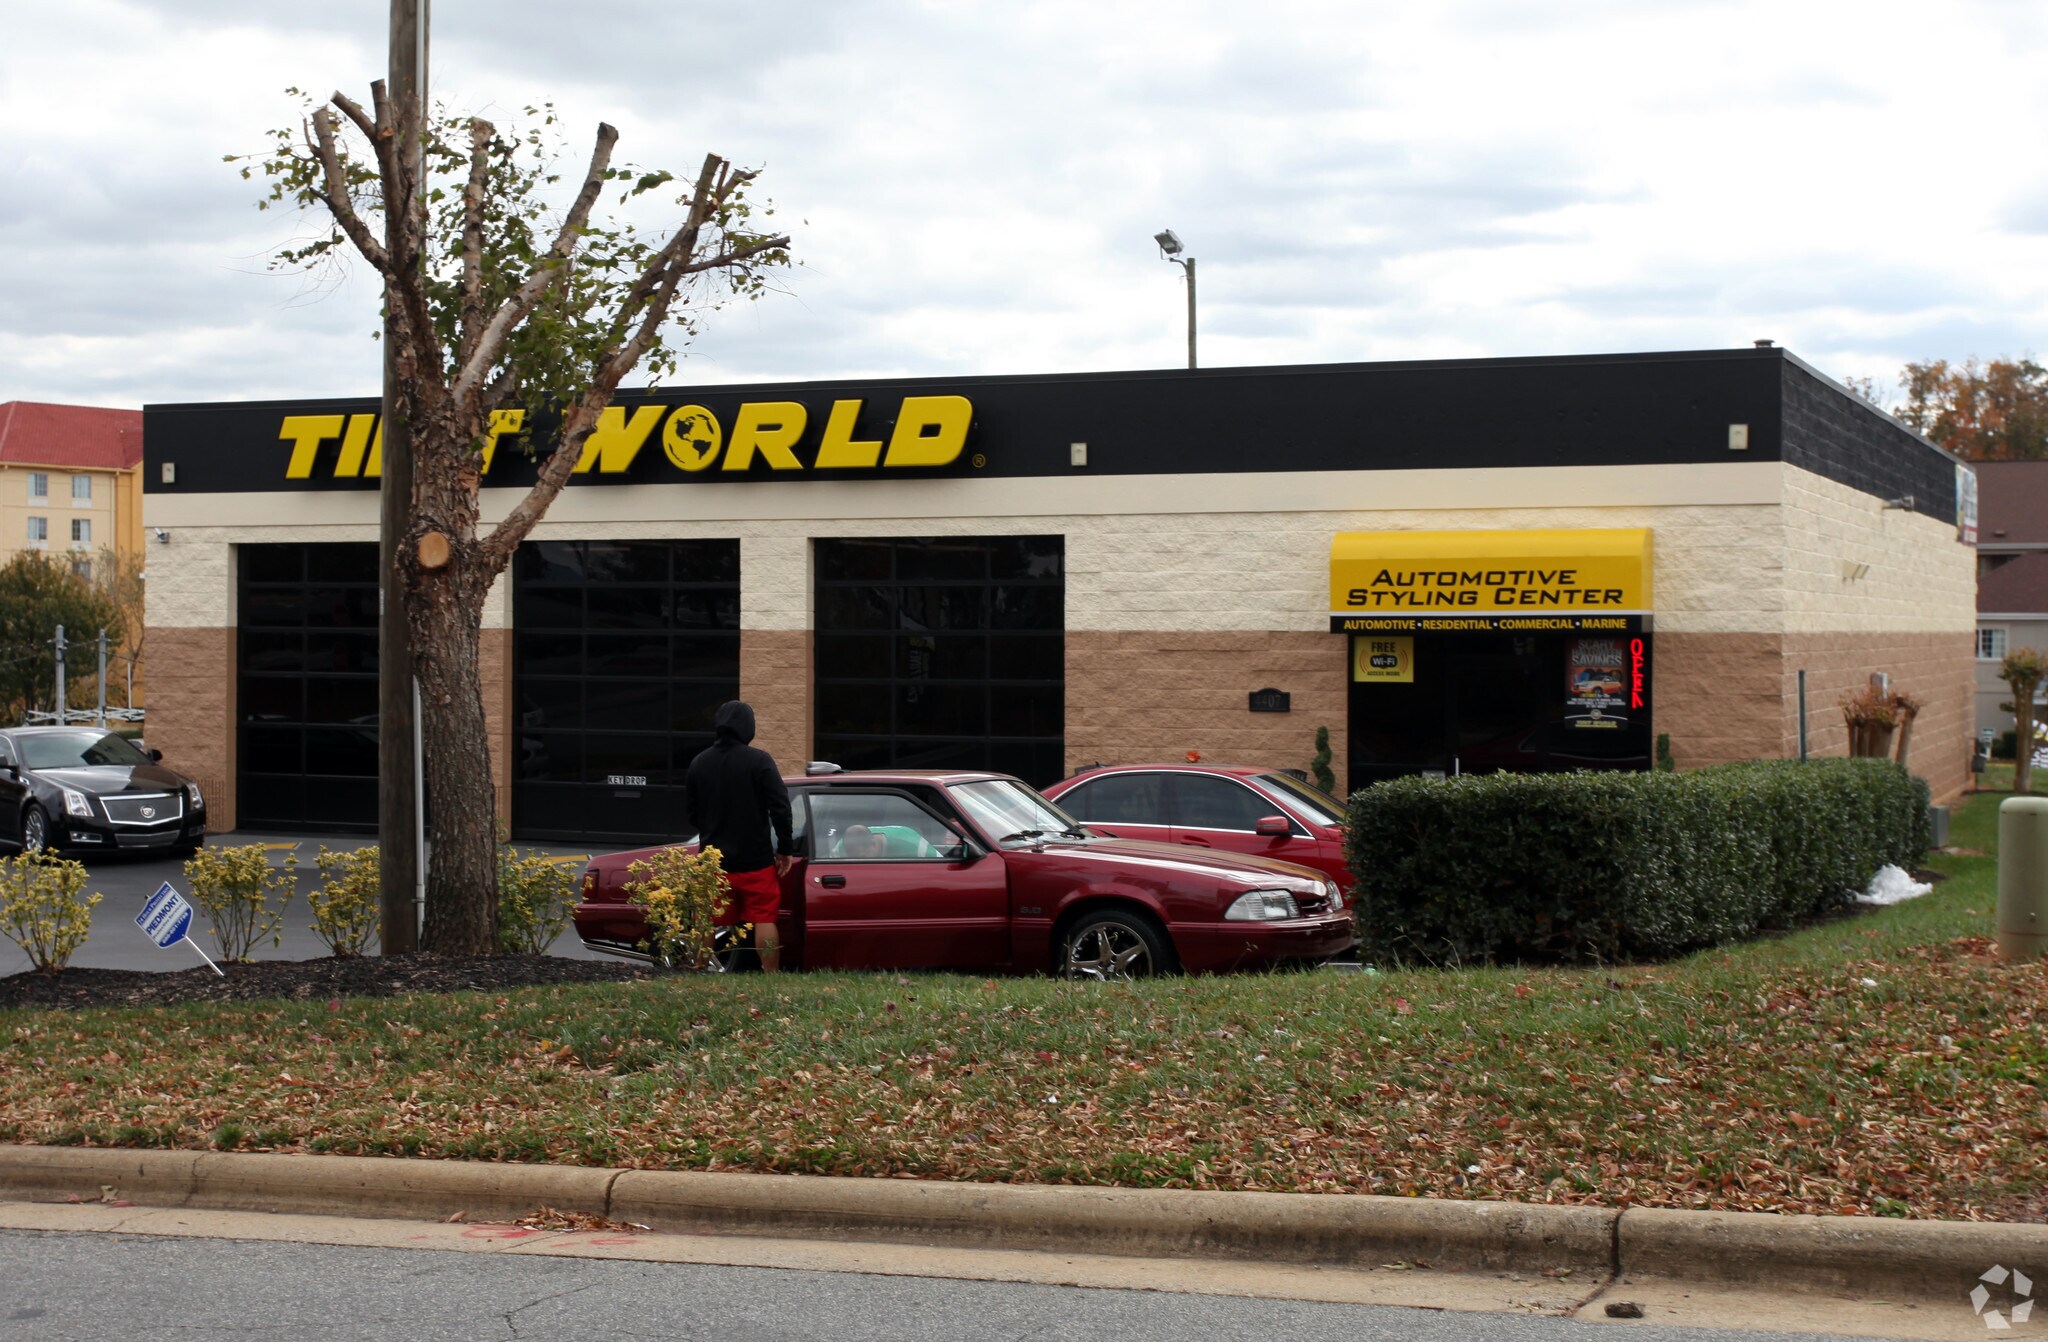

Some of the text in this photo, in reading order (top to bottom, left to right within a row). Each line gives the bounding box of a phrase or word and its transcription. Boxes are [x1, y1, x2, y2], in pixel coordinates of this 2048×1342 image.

[278, 408, 525, 479] TIT
[561, 395, 973, 473] WORLD
[1370, 568, 1578, 587] AUTOMOTIVE
[1346, 587, 1623, 606] STYLING CENTER
[1344, 618, 1627, 630] AUTOMOTIVE RESIDENTIAL COMMERCIAL MARINE
[1371, 642, 1396, 653] FREE
[1578, 639, 1614, 649] SCARY
[1372, 657, 1396, 666] Wi-Fi
[1572, 655, 1622, 667] SAVINGS
[1630, 638, 1644, 709] OPEN
[608, 775, 647, 786] KEY DROP
[146, 894, 178, 935] PIEDMONT
